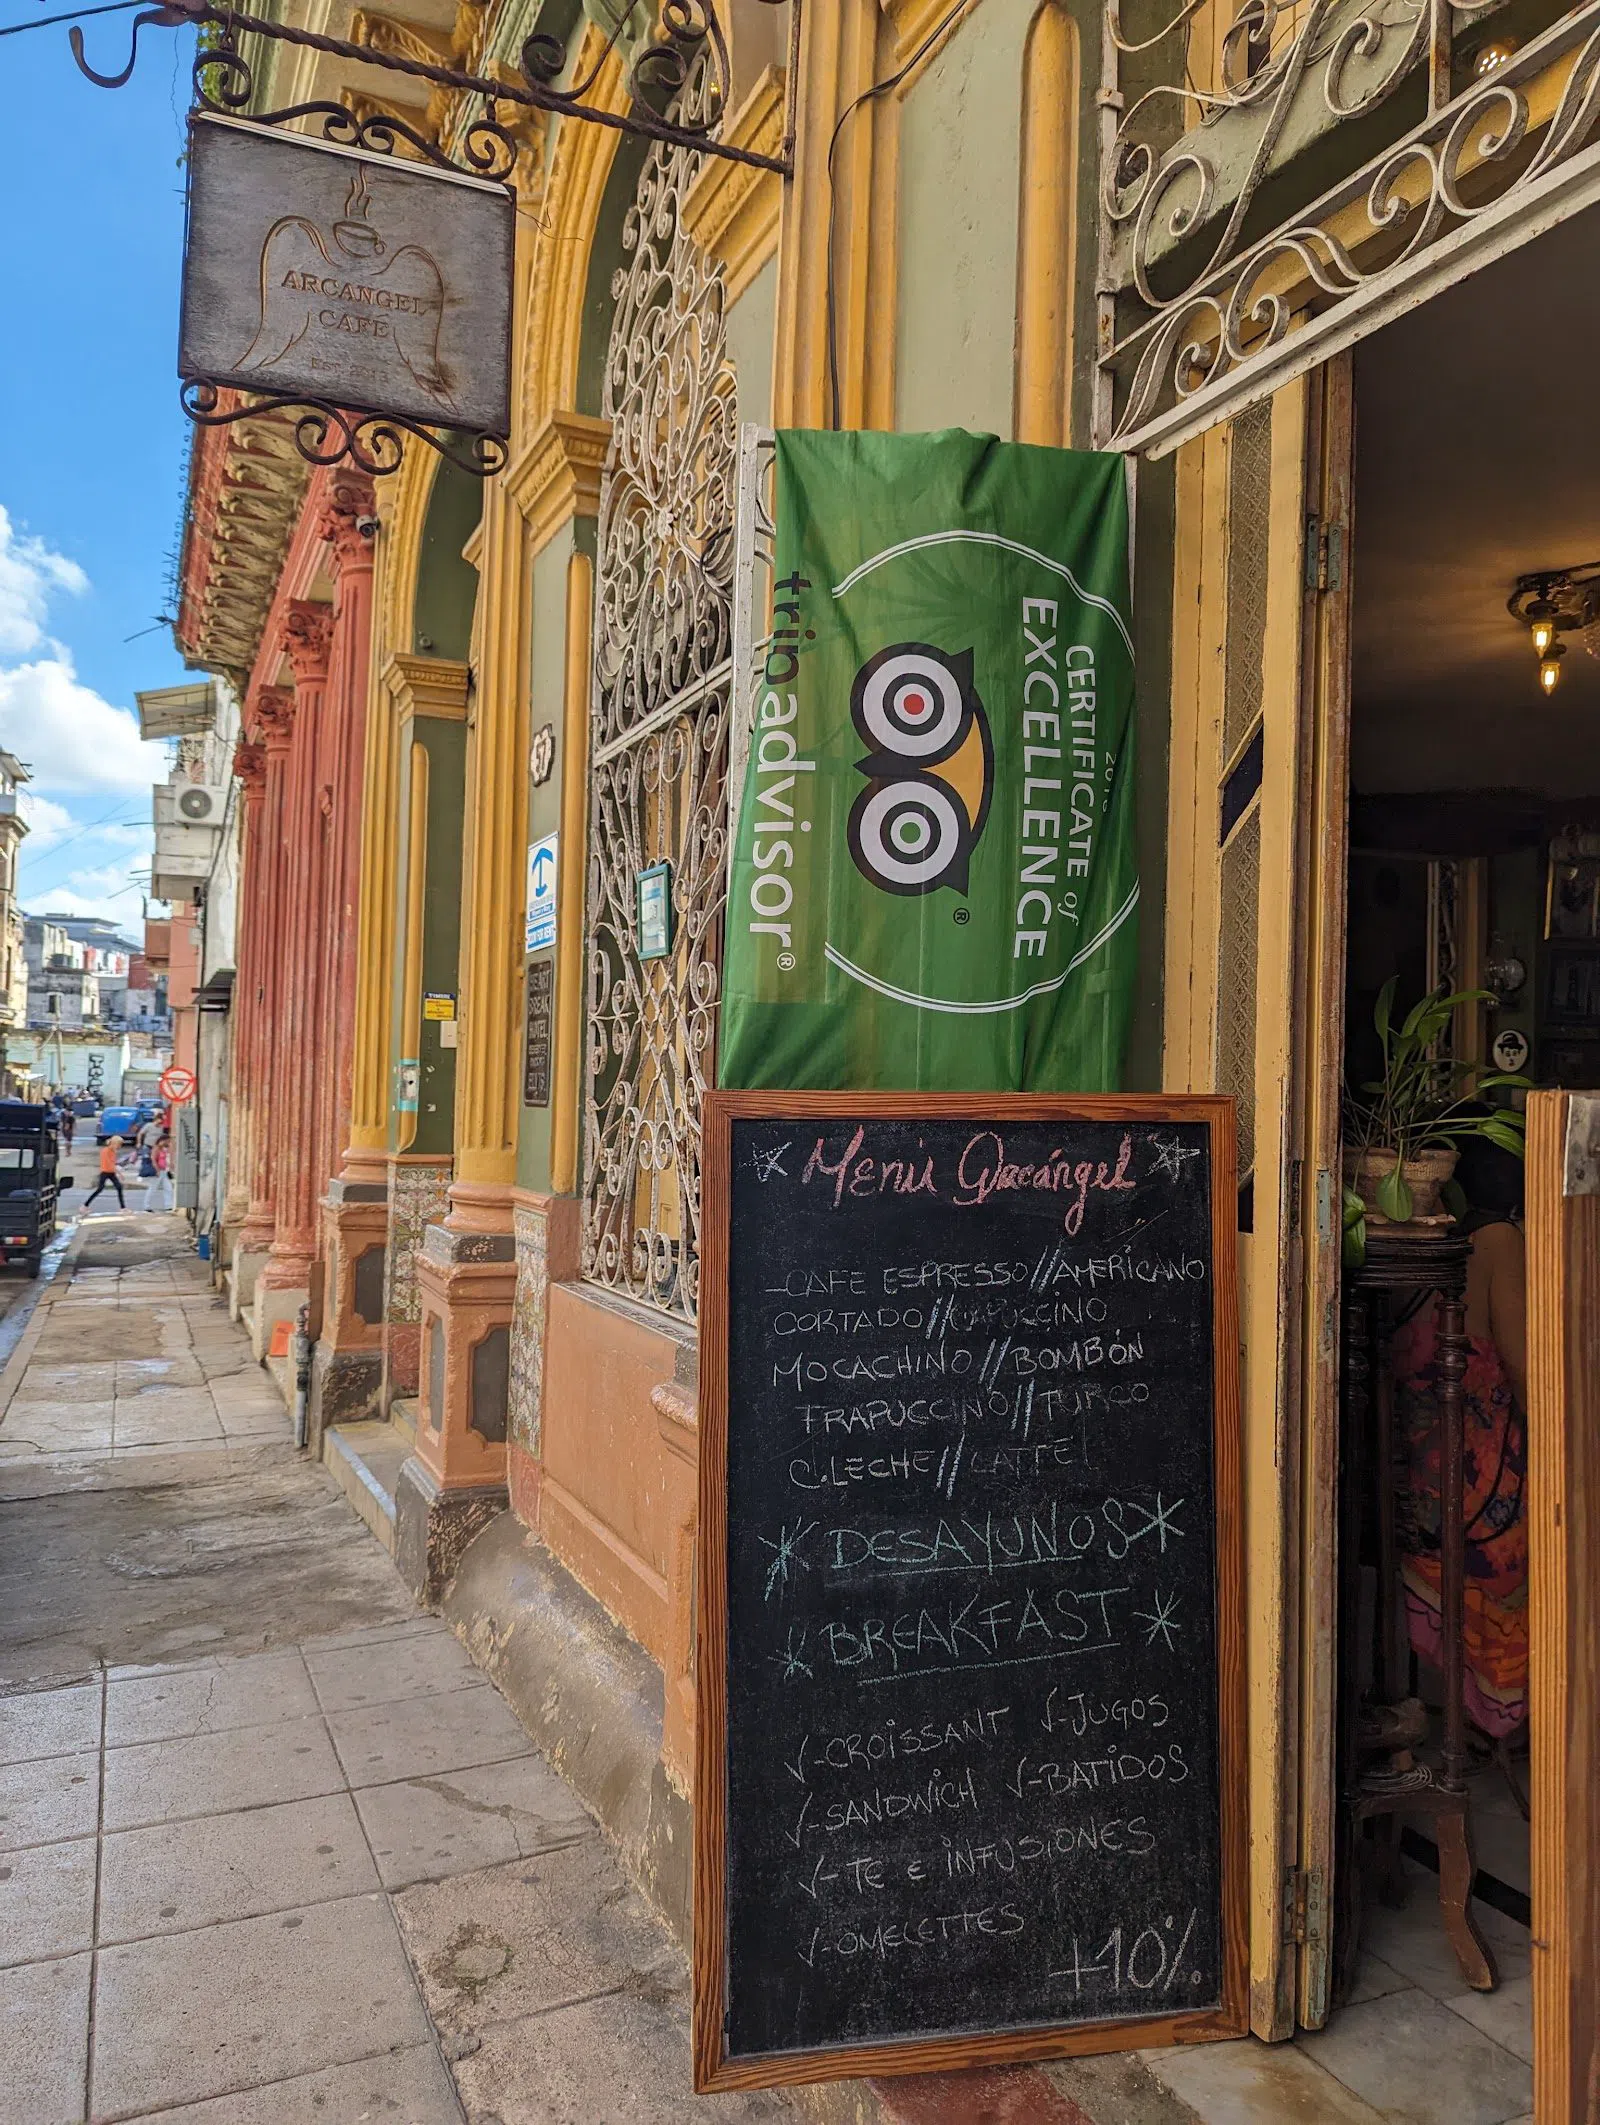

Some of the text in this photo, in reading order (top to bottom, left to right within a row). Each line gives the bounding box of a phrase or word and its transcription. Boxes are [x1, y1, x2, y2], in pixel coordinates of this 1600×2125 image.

[281, 269, 428, 316] ARCANGEL
[319, 309, 390, 337] CAFÉ
[1013, 597, 1060, 958] EXCELLENCE
[1057, 645, 1097, 926] CERTIFICATE of
[824, 1497, 1130, 1576] DESAYUNOS
[819, 1586, 1130, 1670] BREAKFAST
[1049, 1908, 1202, 1992] +10%
